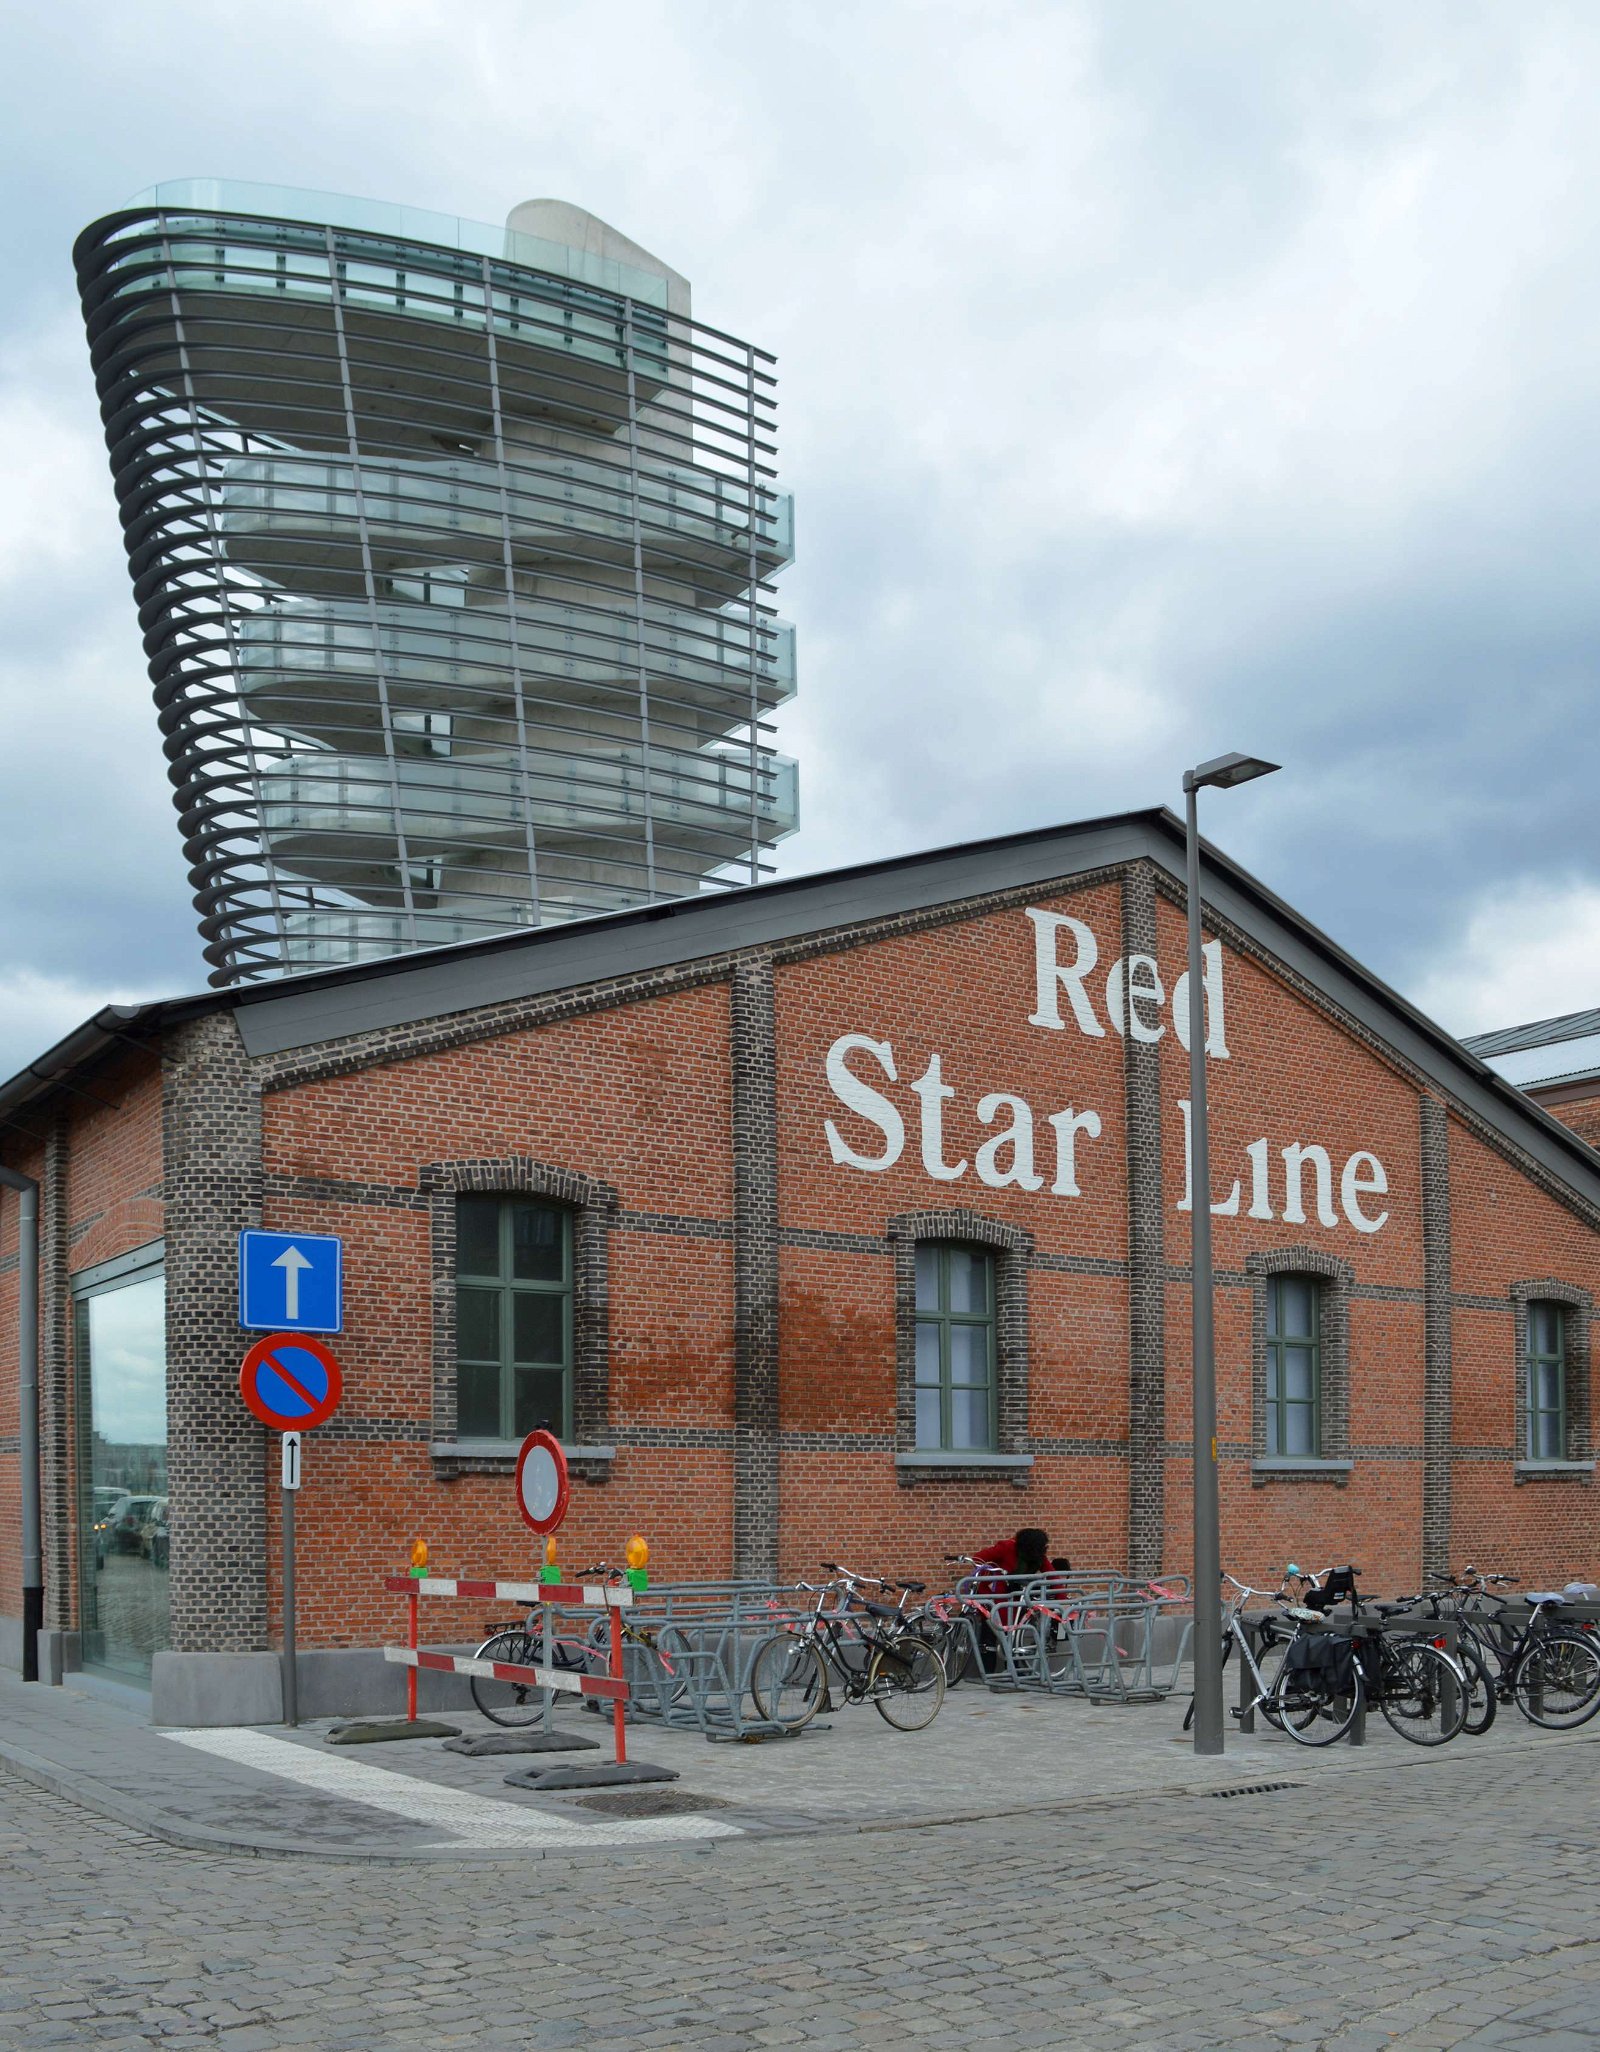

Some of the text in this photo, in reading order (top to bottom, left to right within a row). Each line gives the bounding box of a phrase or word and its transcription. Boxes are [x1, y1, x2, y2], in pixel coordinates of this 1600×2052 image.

[1026, 908, 1229, 1058] Red
[825, 1033, 1389, 1233] Star Line
